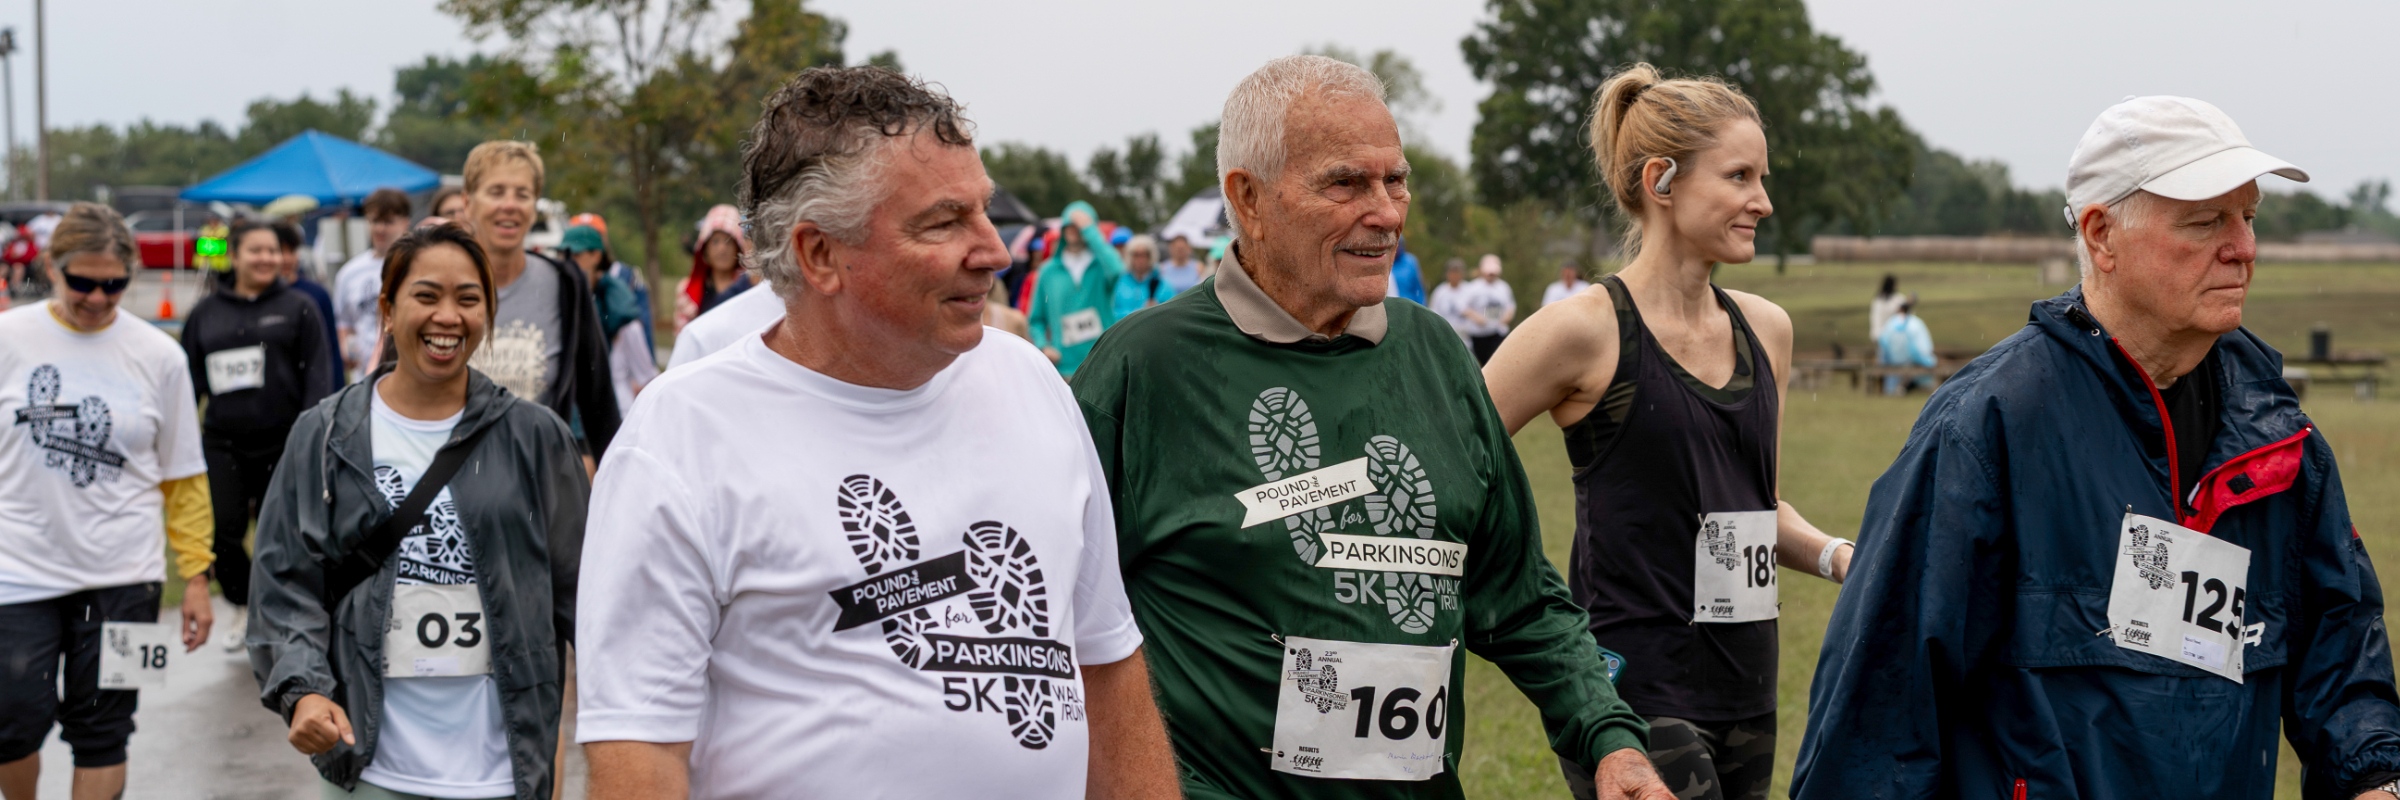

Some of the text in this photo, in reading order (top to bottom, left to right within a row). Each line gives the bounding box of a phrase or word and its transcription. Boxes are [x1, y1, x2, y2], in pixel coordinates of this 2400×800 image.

[1256, 479, 1310, 503] POUND
[1279, 480, 1357, 511] PAVEMENT
[1340, 504, 1365, 529] for
[1330, 541, 1460, 569] PARKINSONS
[852, 573, 910, 604] POUND
[876, 576, 958, 613] PAVEMENT
[1334, 571, 1385, 605] 5K
[1433, 579, 1461, 595] WALK
[945, 605, 973, 628] for
[2181, 571, 2245, 640] 125
[417, 612, 482, 648] 03
[139, 645, 168, 669] 18
[936, 641, 1071, 674] PARKINSONS
[1318, 656, 1343, 664] ANNUAL
[942, 676, 1004, 714] 5K
[1304, 694, 1318, 705] 5K
[1306, 687, 1345, 700] PARKINSONS
[1351, 685, 1446, 740] 160
